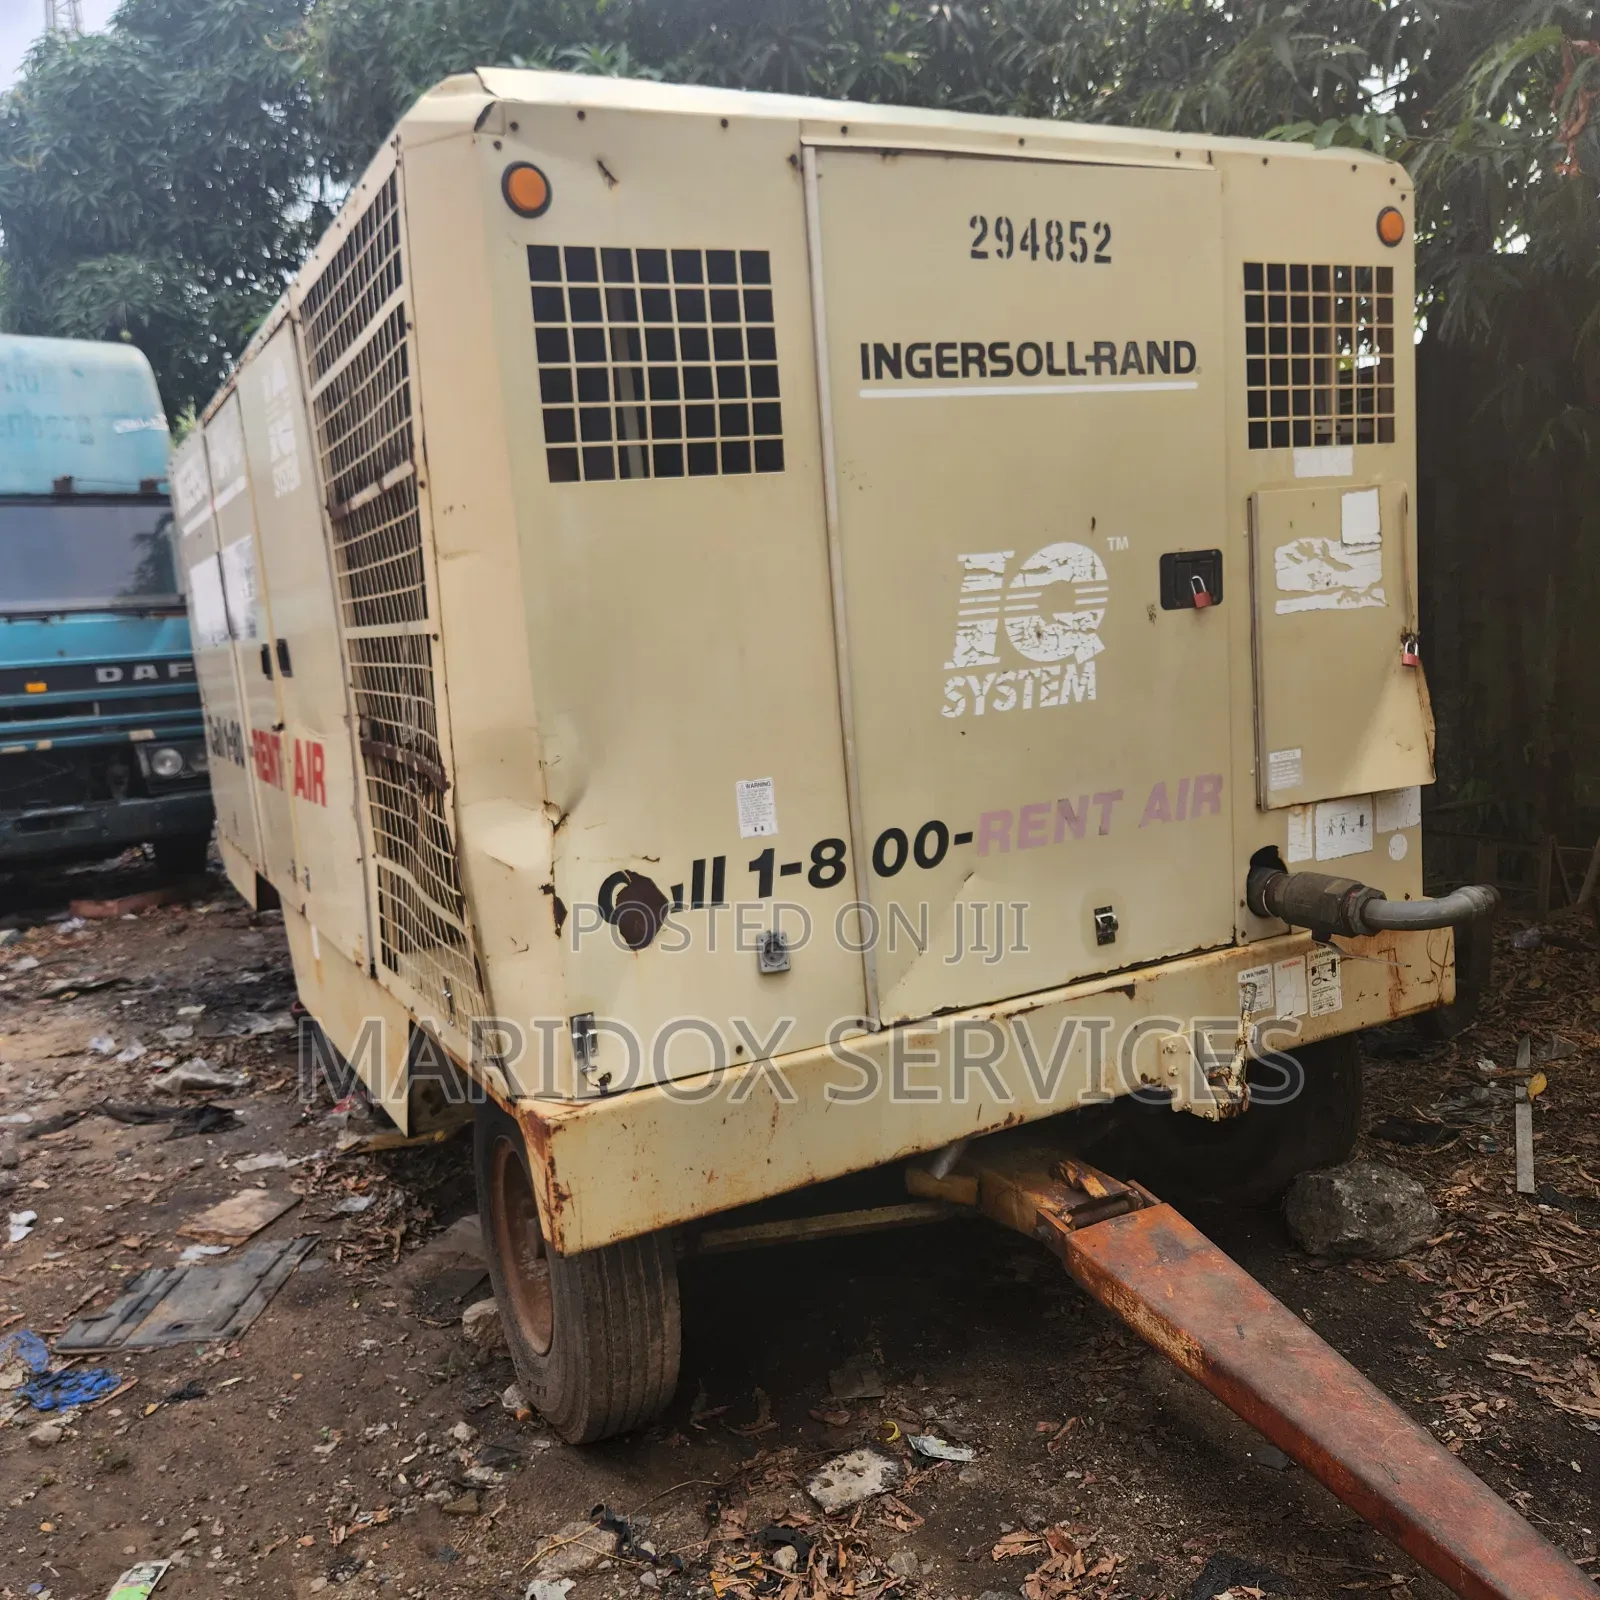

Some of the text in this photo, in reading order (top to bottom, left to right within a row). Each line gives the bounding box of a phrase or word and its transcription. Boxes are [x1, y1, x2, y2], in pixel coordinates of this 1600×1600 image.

[969, 215, 1112, 264] 294852
[860, 340, 1197, 380] INGERSOLL-RAND
[95, 663, 194, 683] DAF
[941, 661, 1097, 718] SYSTEM
[294, 738, 327, 808] AIR
[745, 780, 771, 789] WARNING
[1138, 774, 1223, 828] AIR
